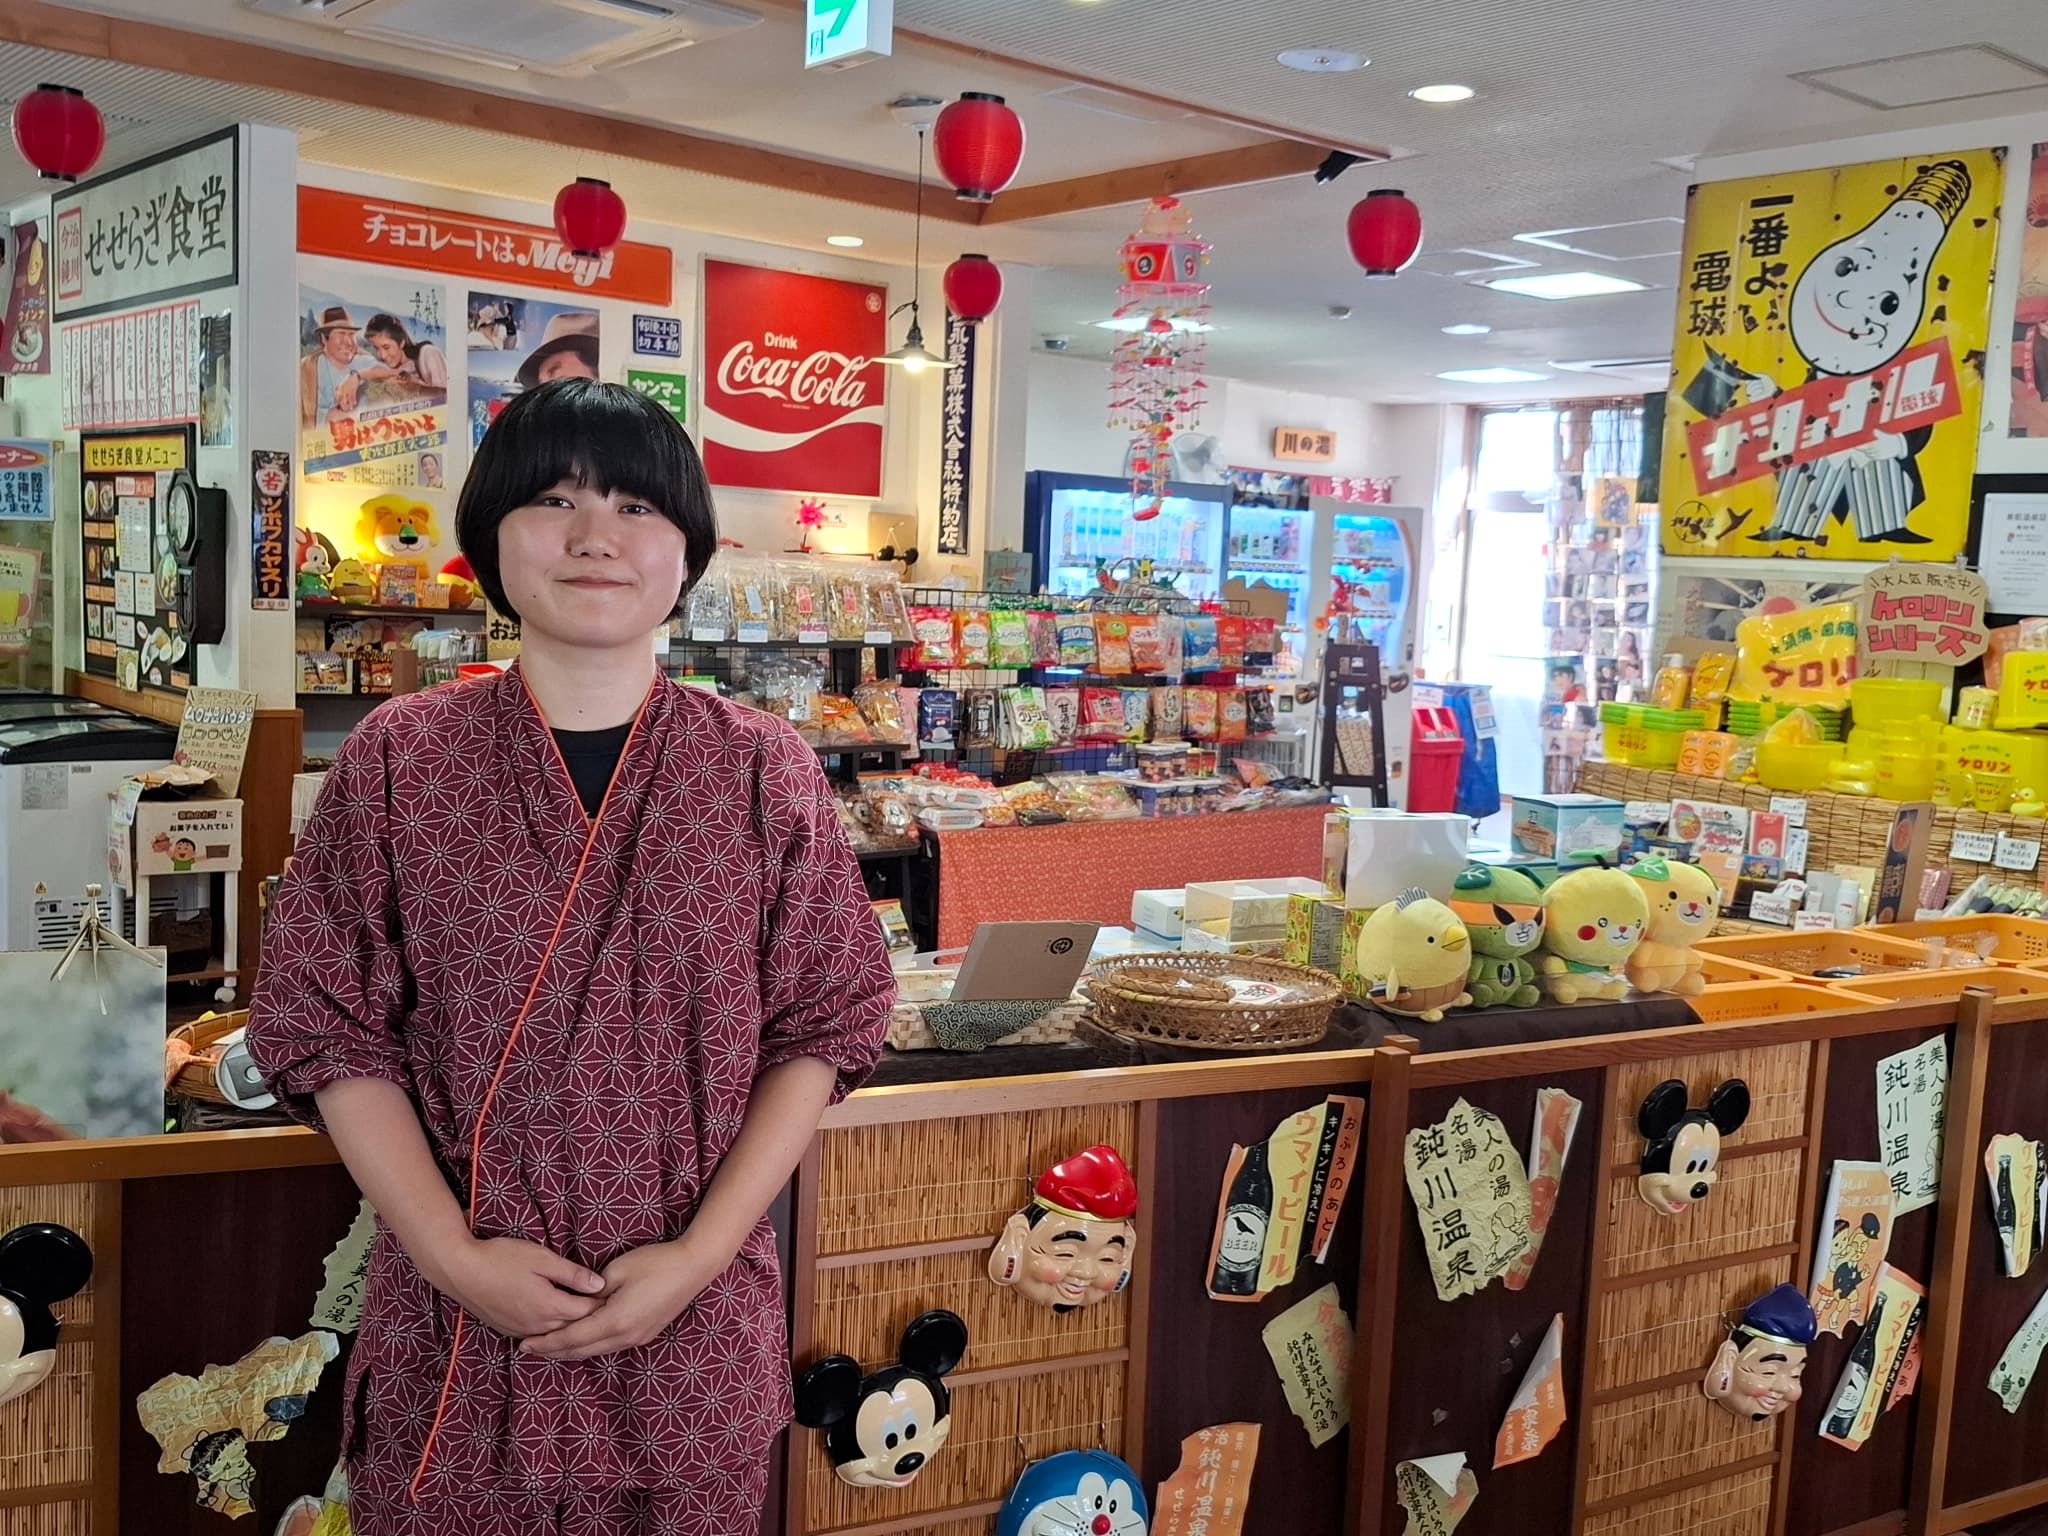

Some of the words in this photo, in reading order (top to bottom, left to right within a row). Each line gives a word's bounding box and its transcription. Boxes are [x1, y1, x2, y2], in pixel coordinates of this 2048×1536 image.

[85, 174, 227, 278] せせらぎ食堂
[362, 213, 516, 264] チョコレートは
[517, 239, 615, 287] Meiji
[1687, 251, 1732, 336] 電球
[764, 332, 798, 350] Drink
[717, 341, 870, 408] Coca-Cola
[91, 446, 178, 467] せせらぎ食堂メニュー
[329, 413, 437, 451] 男はつらいよ
[1282, 432, 1332, 456] 川の湯
[1871, 590, 1975, 628] ケロリン
[1866, 623, 1983, 658] シリーズ
[1957, 756, 2012, 775] ケロリン
[1912, 1053, 1929, 1096] 名湯
[1929, 1045, 1945, 1132] 美人の湯
[1451, 1114, 1477, 1164] 名湯
[1471, 1106, 1512, 1201] 美人の湯
[1884, 1059, 1912, 1200] 鈍川温泉
[1266, 1112, 1318, 1279] ウマイビール
[1412, 1126, 1477, 1290] 鈍川温泉
[1224, 1238, 1258, 1252] BEER
[1856, 1300, 1911, 1431] ウマイビール
[1198, 1429, 1229, 1445] 今治
